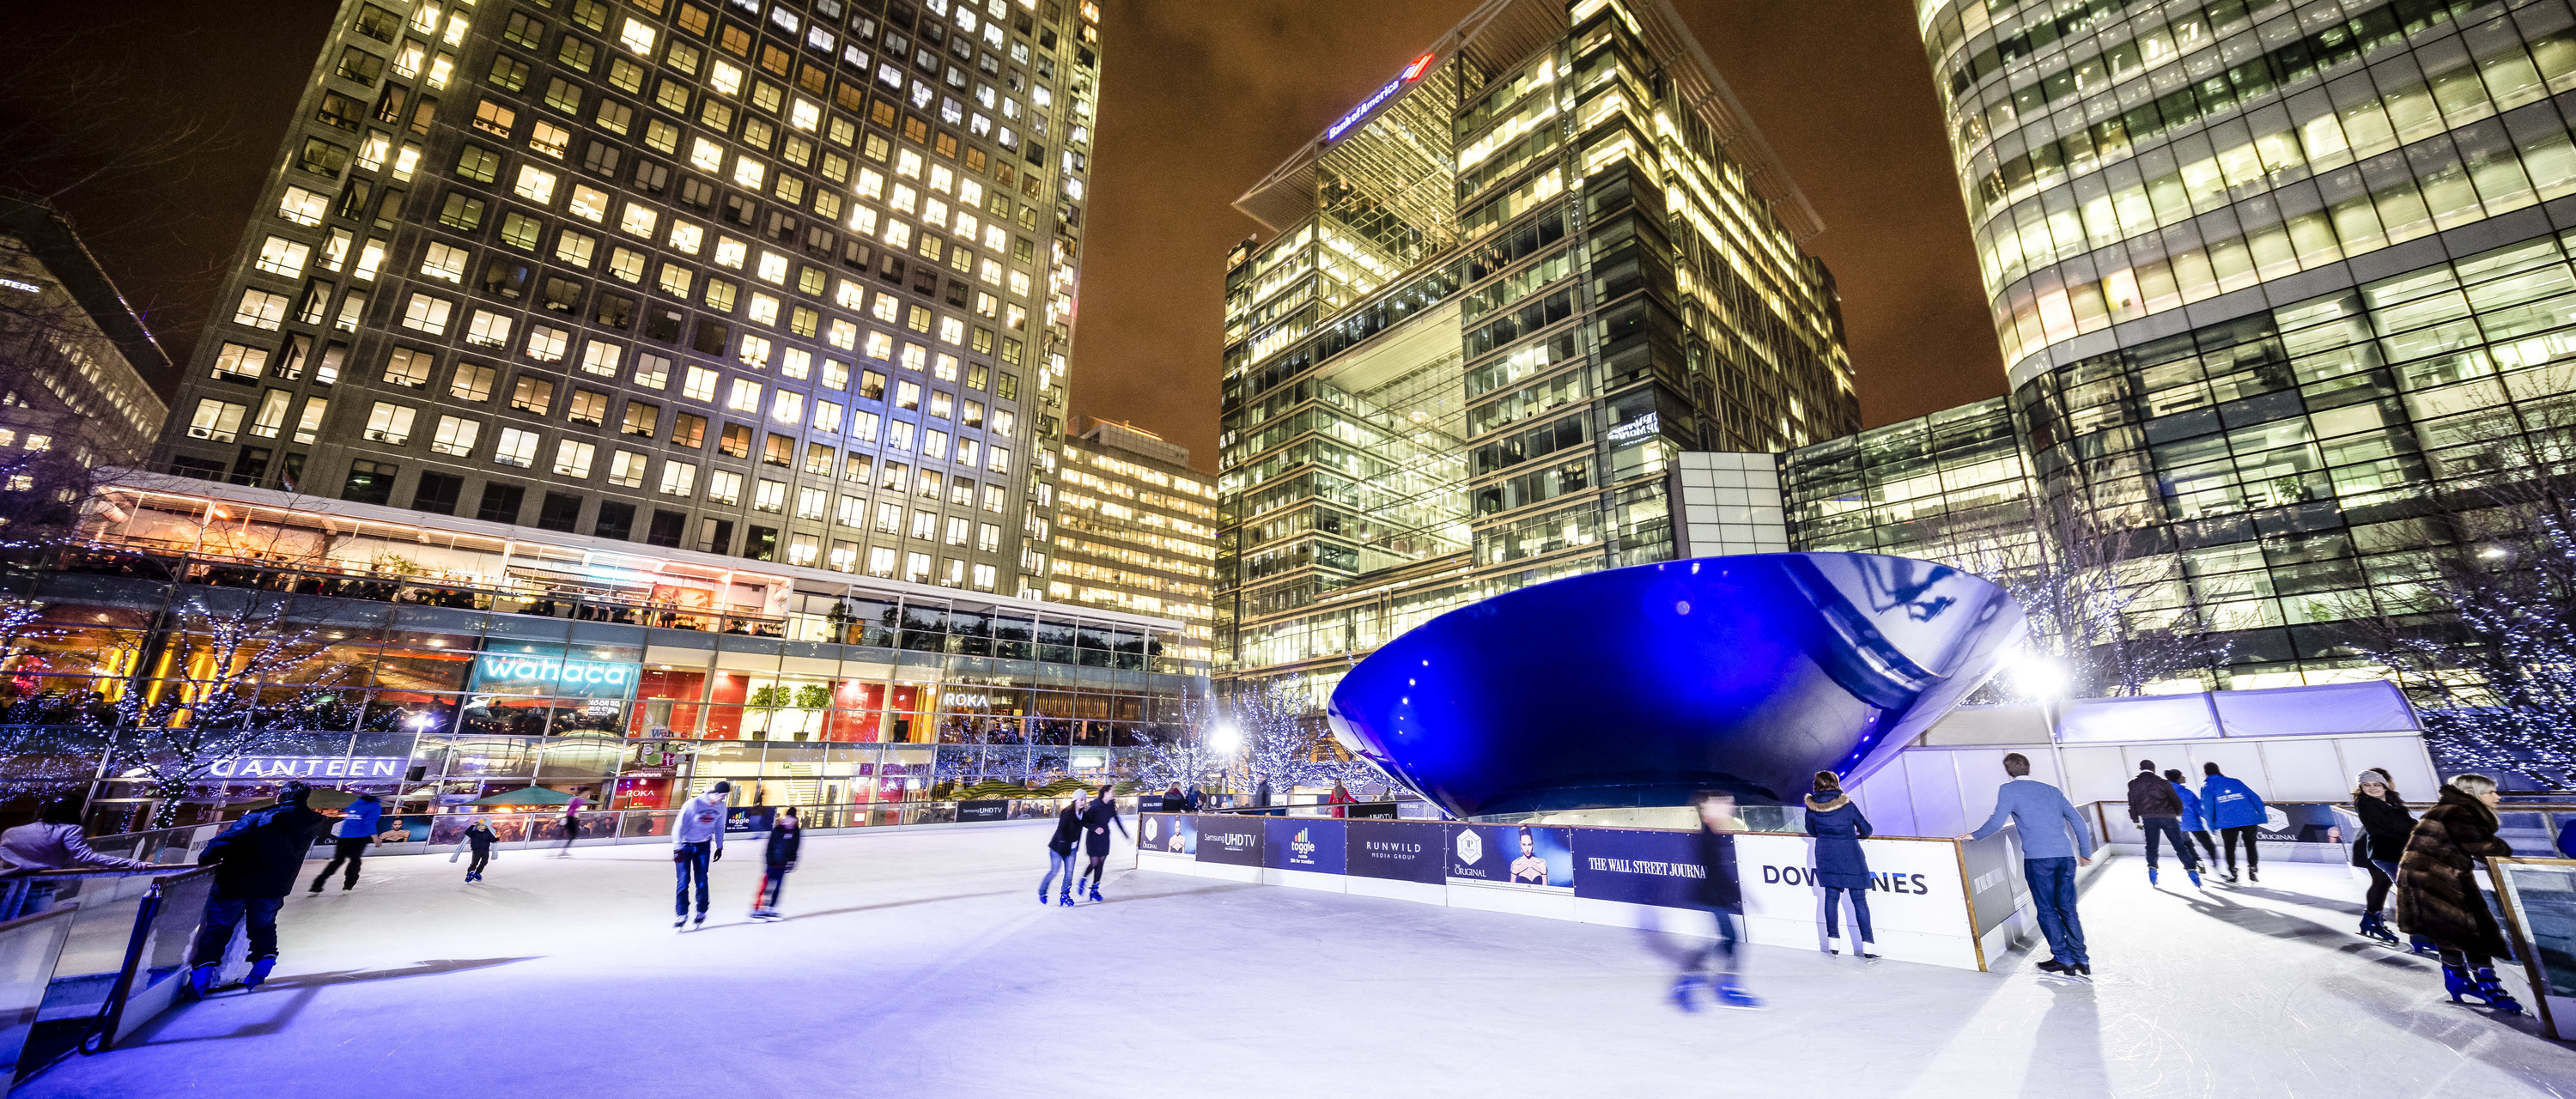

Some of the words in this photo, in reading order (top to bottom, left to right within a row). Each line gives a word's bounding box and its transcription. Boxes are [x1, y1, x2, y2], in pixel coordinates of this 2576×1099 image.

[486, 659, 626, 685] wahaca
[945, 692, 987, 707] ROKA
[210, 760, 397, 776] CANTEEN
[1204, 833, 1224, 843] Samsung
[1291, 841, 1315, 854] toggle
[1366, 841, 1421, 853] RUNWILD
[1455, 867, 1486, 877] ORIGINAL
[1589, 857, 1607, 871] THE
[1608, 859, 1632, 872] WALL
[1632, 860, 1668, 876] STREET
[1669, 863, 1706, 878] JOURNA
[1869, 871, 1929, 896] NES
